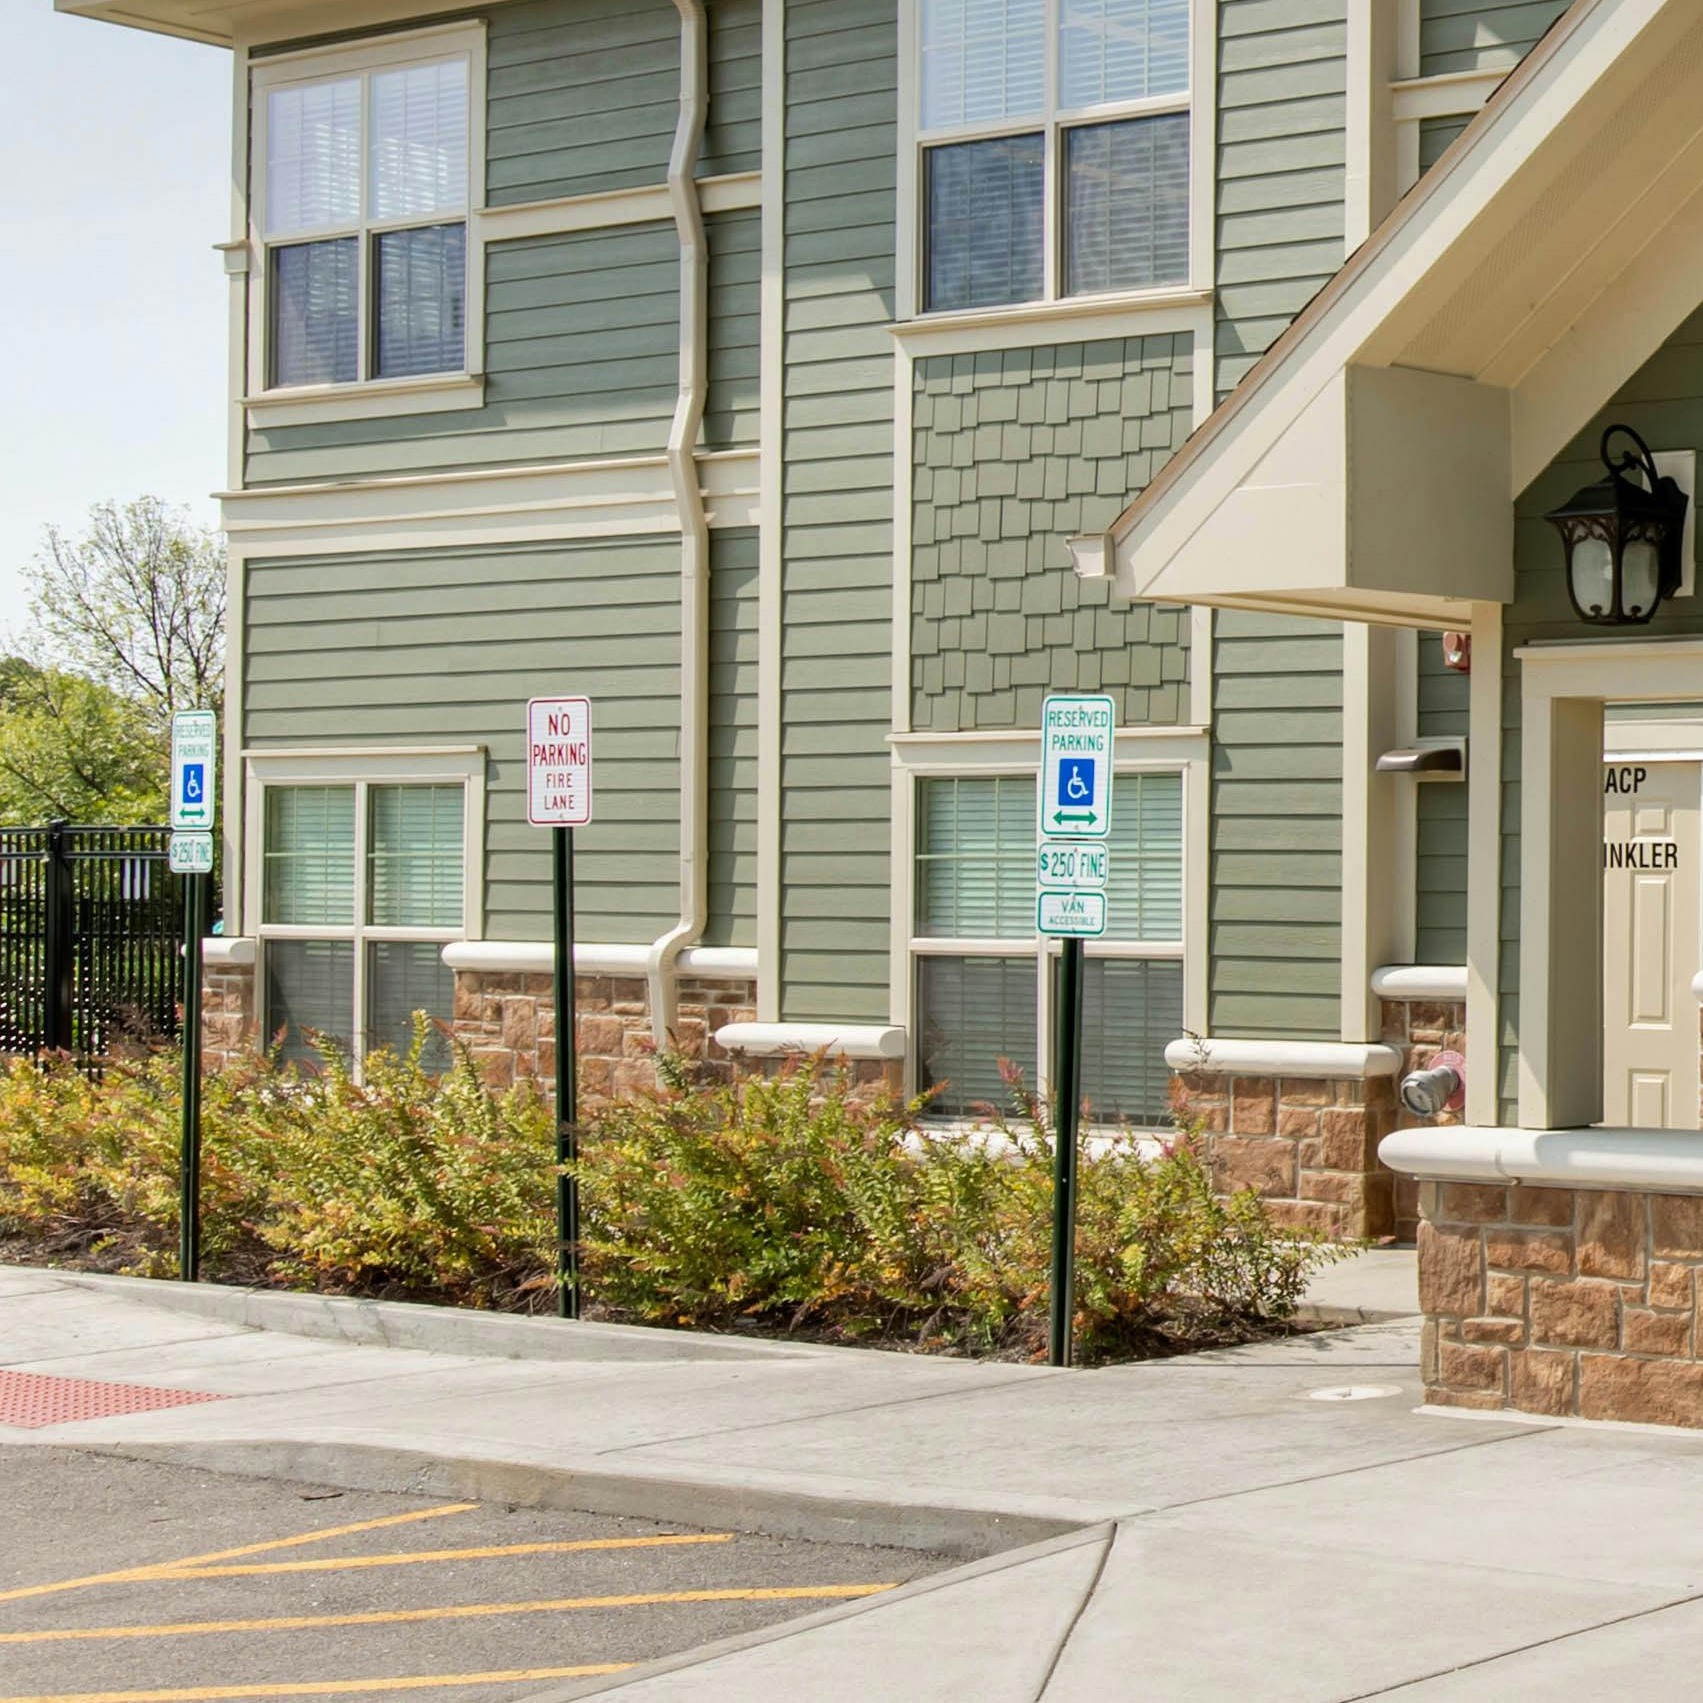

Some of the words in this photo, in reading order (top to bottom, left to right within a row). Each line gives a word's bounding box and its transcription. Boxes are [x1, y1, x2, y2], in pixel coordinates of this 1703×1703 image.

[548, 713, 571, 736] NO
[1049, 711, 1108, 727] RESERVED
[1052, 734, 1104, 751] PARKING
[533, 743, 586, 766] PARKING
[546, 773, 573, 788] FIRE
[1604, 767, 1647, 794] ACP
[544, 795, 575, 810] LANE
[1080, 853, 1105, 877] FINE
[1061, 900, 1085, 913] VAN
[1048, 915, 1096, 926] ACCESSIBLE
